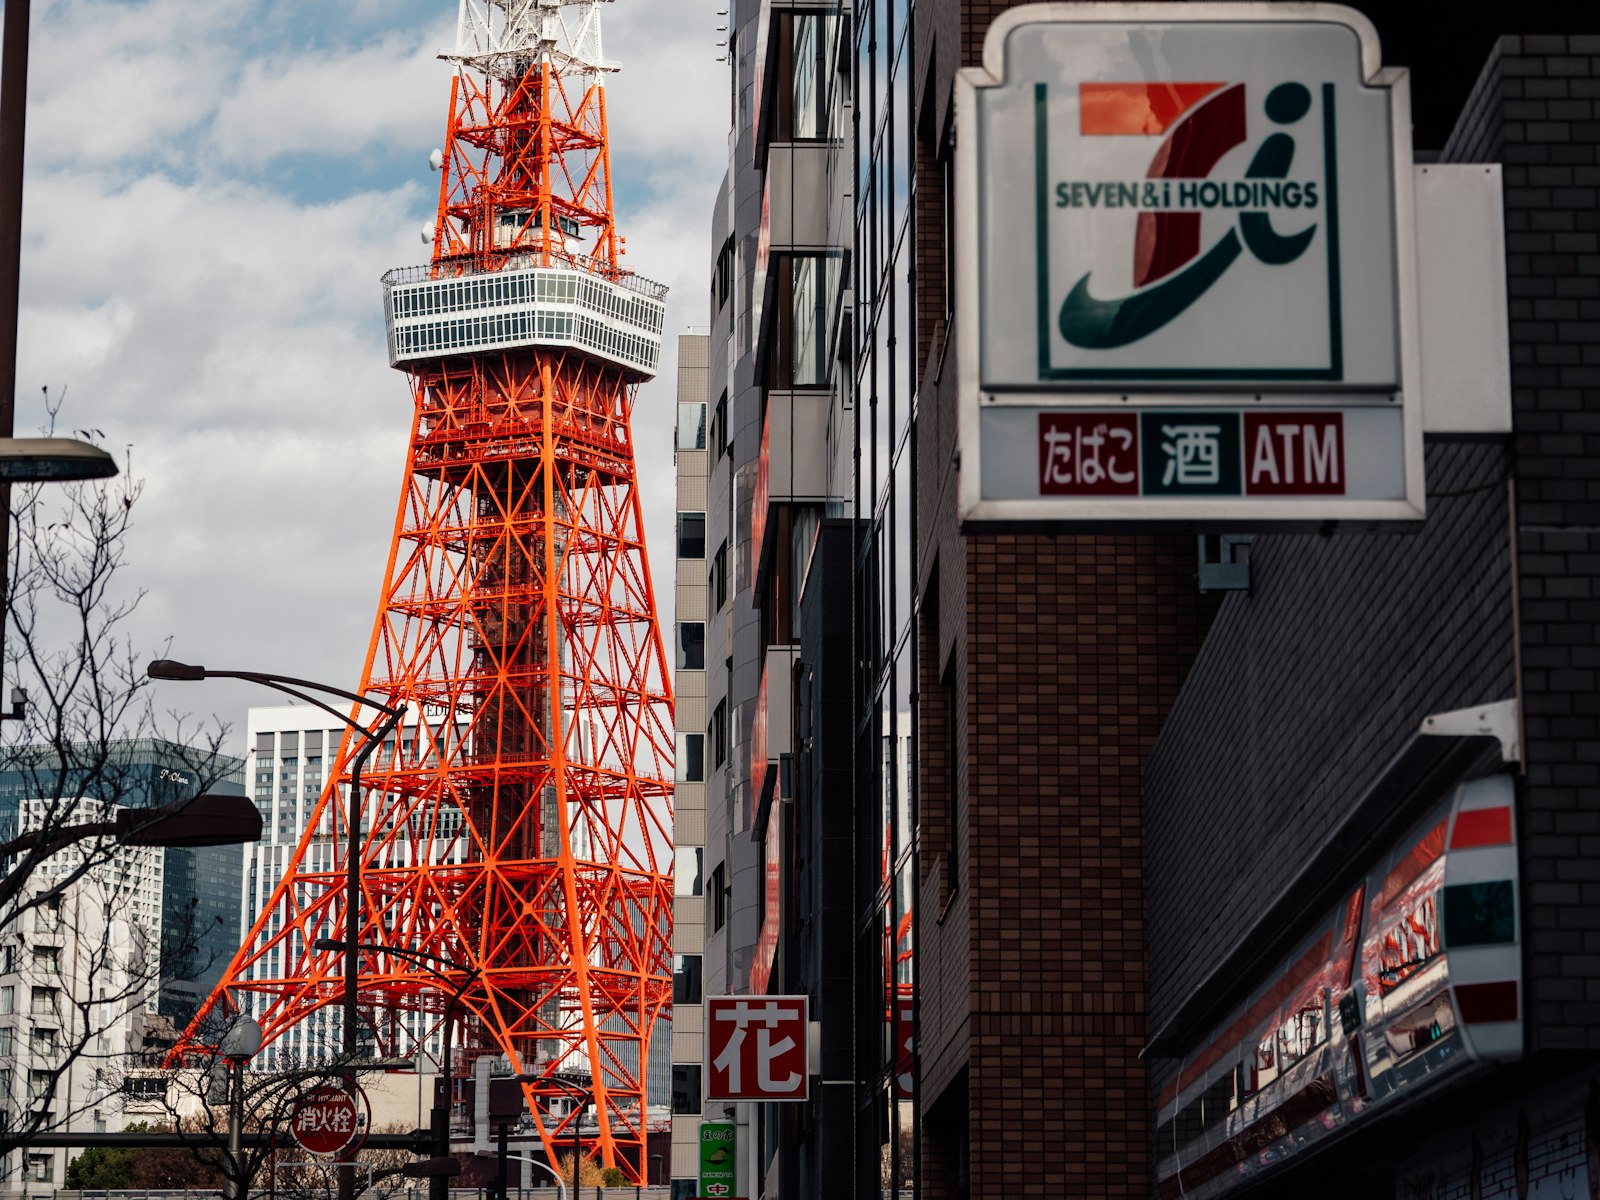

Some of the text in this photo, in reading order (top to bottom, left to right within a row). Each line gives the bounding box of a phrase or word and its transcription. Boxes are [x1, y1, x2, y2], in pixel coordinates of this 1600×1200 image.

[1179, 181, 1318, 209] HOLDINGS
[1044, 424, 1135, 484] たばこ
[1161, 424, 1221, 486] 酒
[1251, 424, 1338, 484] ATM
[713, 1002, 802, 1093] 花
[296, 1106, 352, 1132] 消火栓
